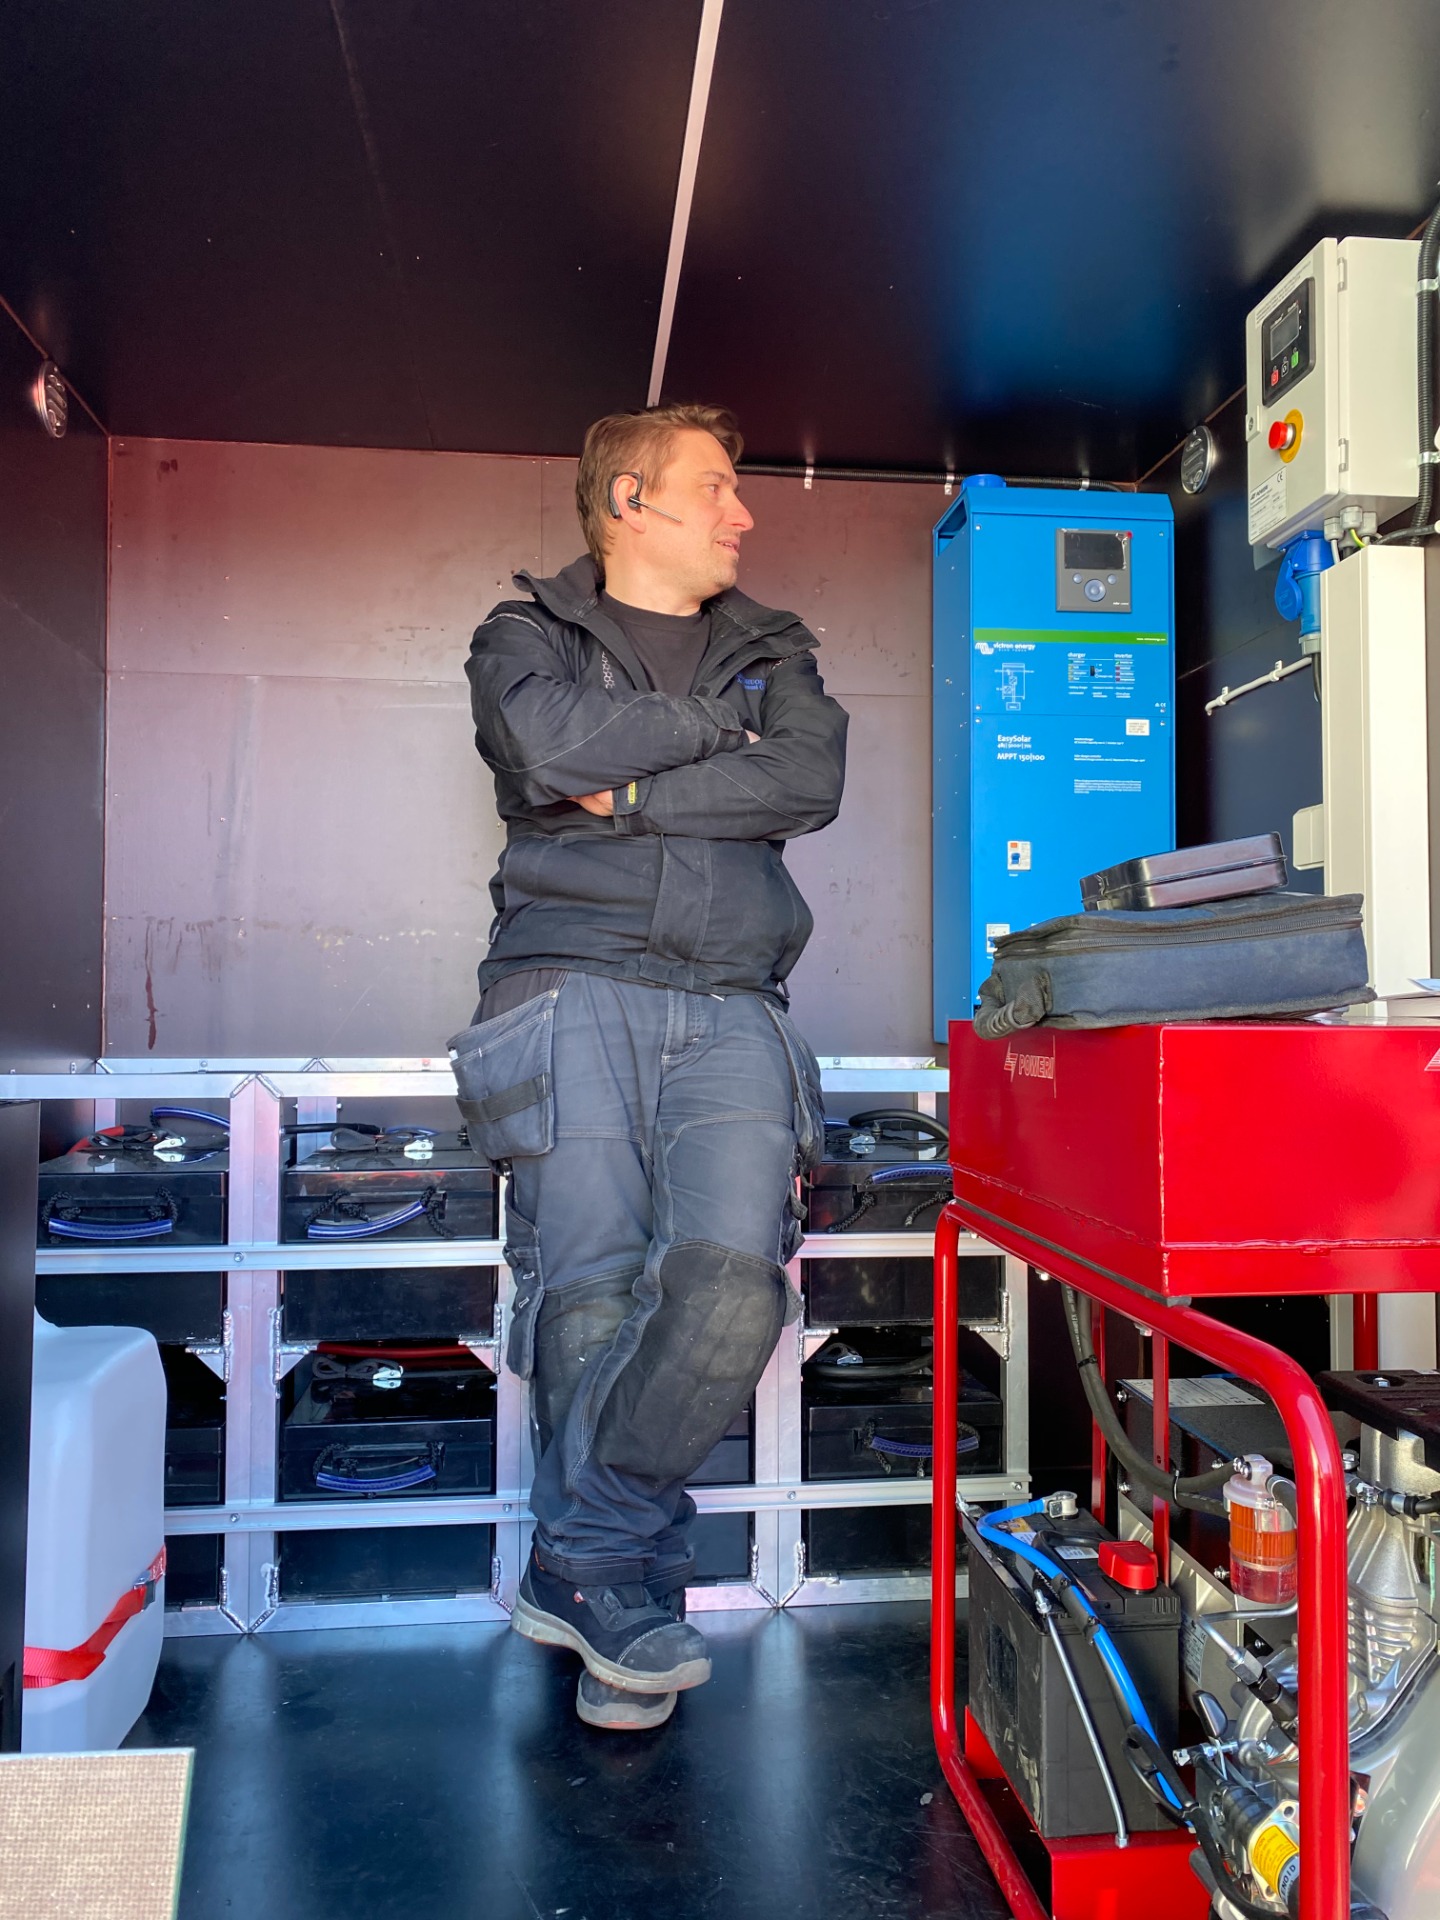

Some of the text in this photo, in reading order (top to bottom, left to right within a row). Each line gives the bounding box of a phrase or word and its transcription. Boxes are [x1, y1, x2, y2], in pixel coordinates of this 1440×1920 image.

[993, 642, 1036, 652] victron energy
[997, 734, 1032, 744] EasySolar
[997, 752, 1018, 761] MPPT
